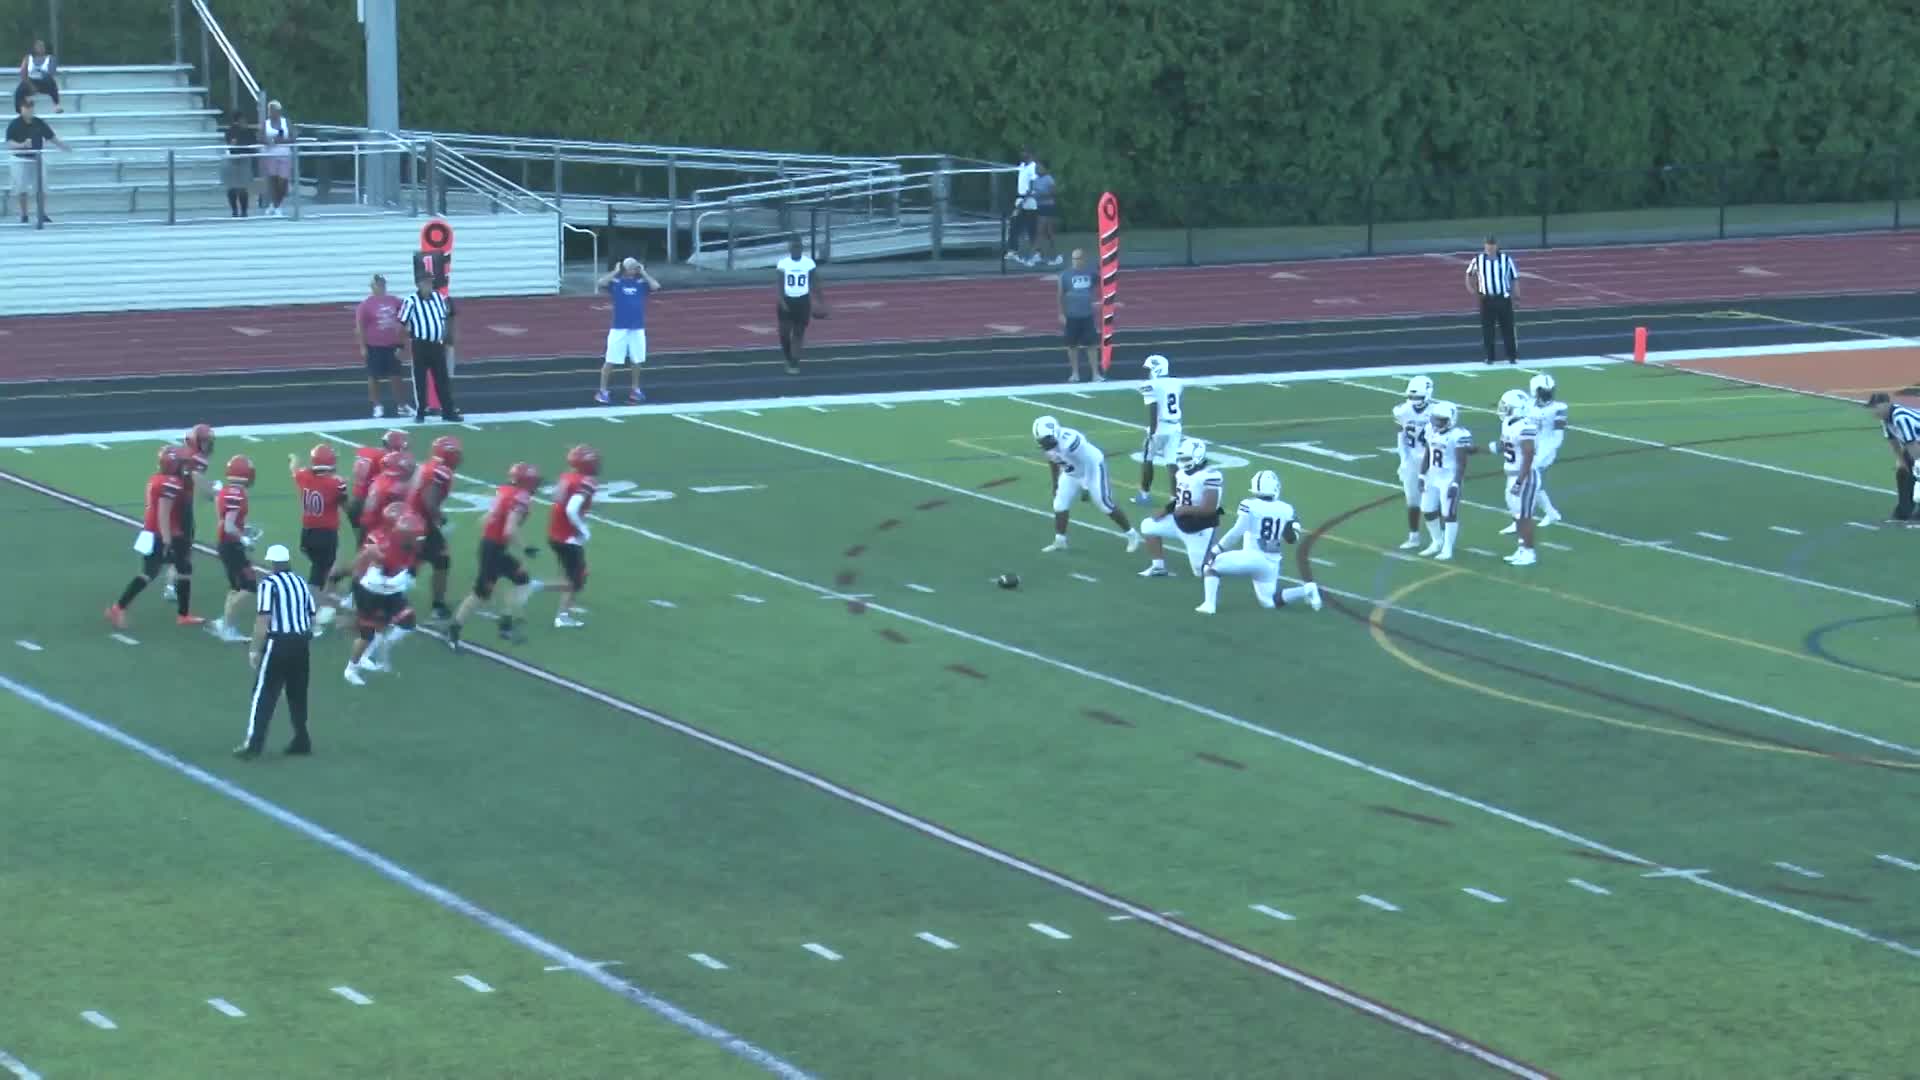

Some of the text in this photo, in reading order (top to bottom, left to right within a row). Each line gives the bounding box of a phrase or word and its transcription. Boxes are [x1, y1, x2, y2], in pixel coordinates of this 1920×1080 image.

[786, 274, 806, 287] 00
[1166, 393, 1177, 414] 2
[303, 487, 325, 518] 10
[1260, 517, 1280, 541] 81
